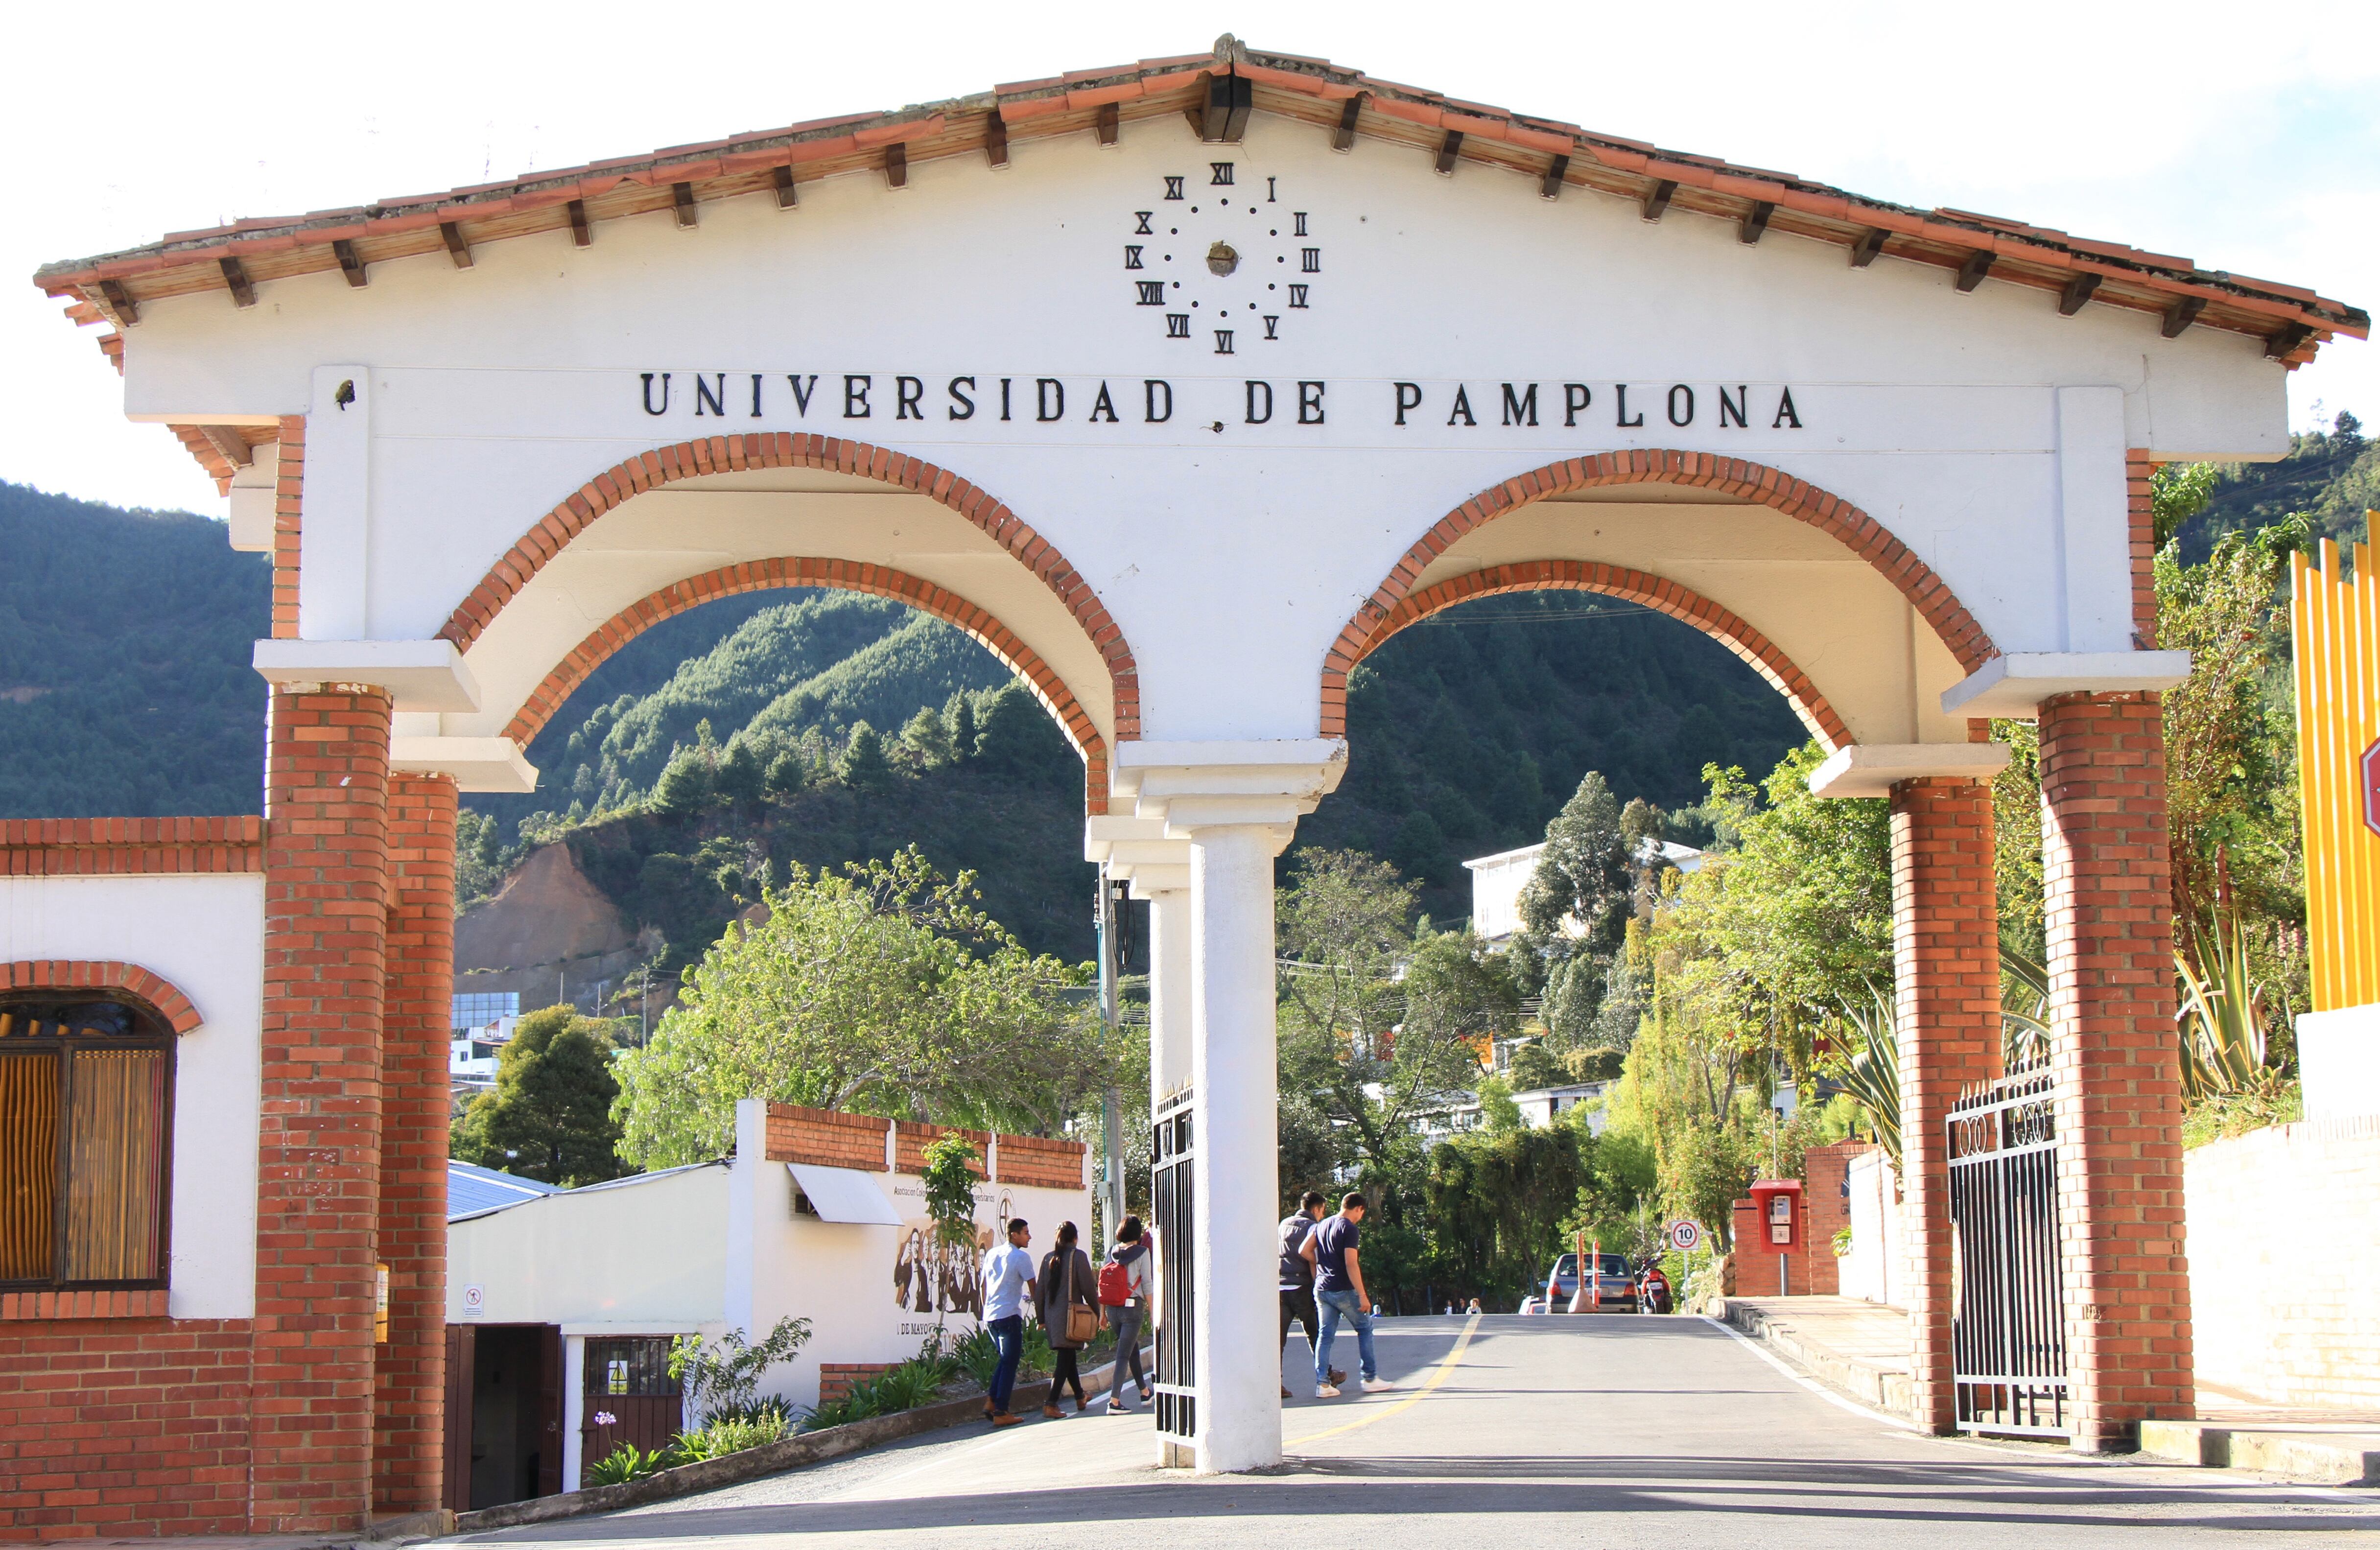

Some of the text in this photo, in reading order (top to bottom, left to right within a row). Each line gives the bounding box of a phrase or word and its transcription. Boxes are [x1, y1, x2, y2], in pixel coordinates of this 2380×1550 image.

[1210, 163, 1234, 186] XII
[1163, 176, 1184, 200] XI
[1267, 176, 1276, 203] I
[1134, 211, 1153, 235] X
[1293, 212, 1308, 236] II
[1125, 245, 1144, 270] IX
[1301, 248, 1320, 273] III
[1135, 281, 1166, 305] VIII
[1288, 284, 1309, 308] IV
[1166, 314, 1191, 338] VII
[1263, 316, 1279, 340] V
[1214, 330, 1234, 354] VI
[640, 373, 1803, 428] UNIVERSIDAD DE PAMPLONA
[1678, 1228, 1693, 1240] 10
[901, 1323, 910, 1335] DE
[911, 1323, 928, 1335] MAYO
